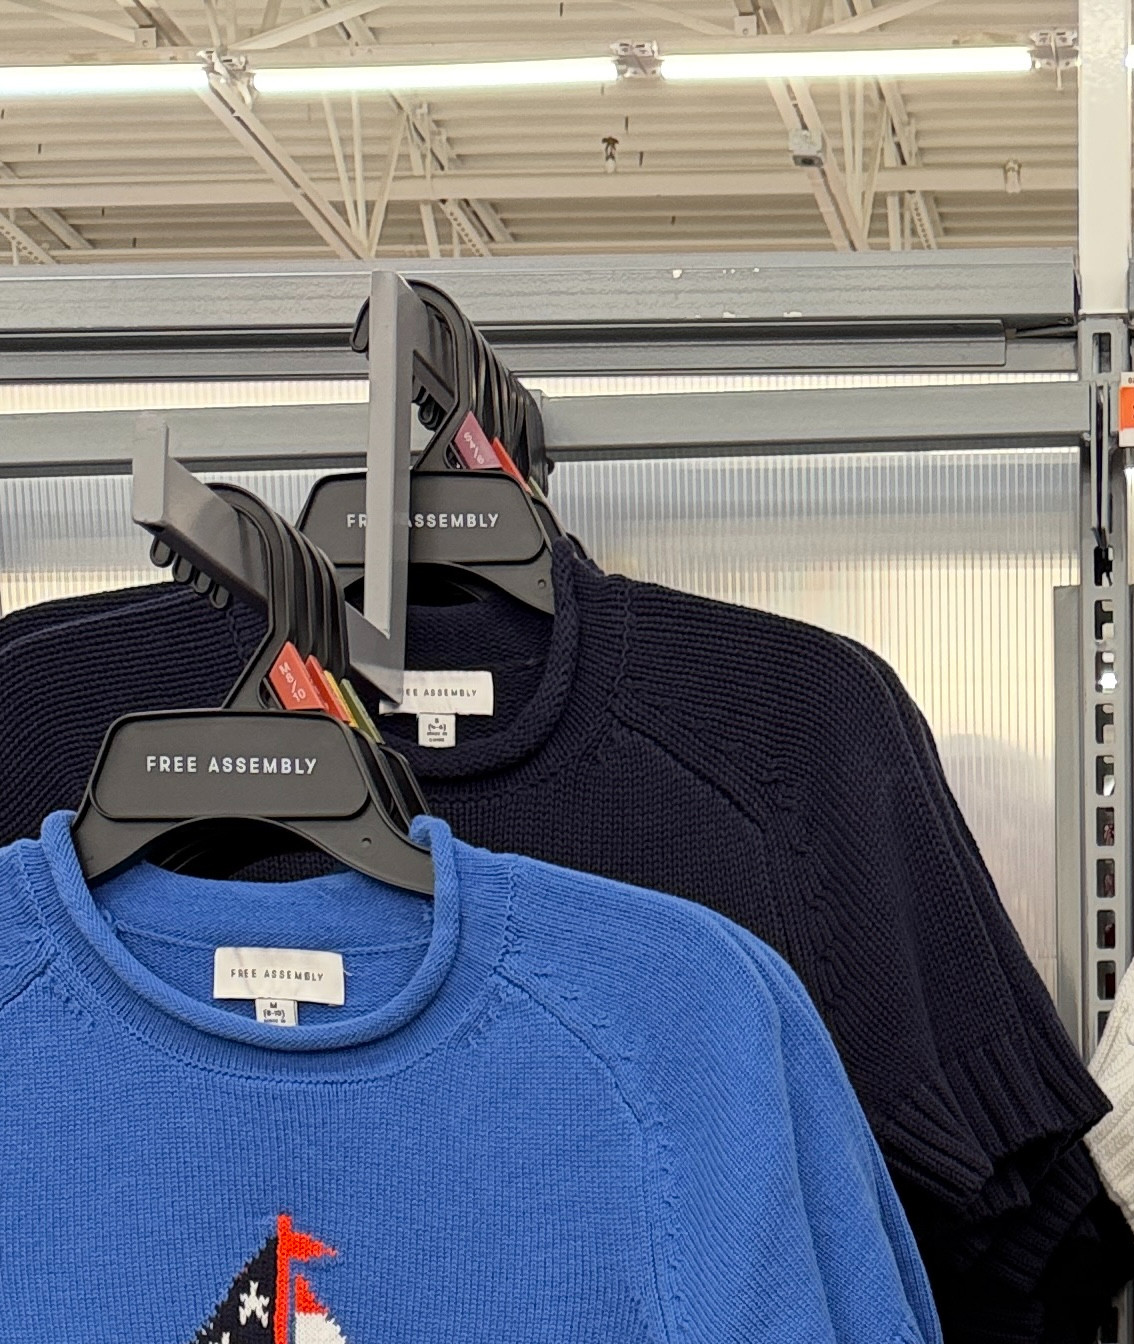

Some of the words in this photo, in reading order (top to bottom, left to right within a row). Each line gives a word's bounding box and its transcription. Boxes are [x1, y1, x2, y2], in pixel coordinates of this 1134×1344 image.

[347, 513, 367, 528] FR
[279, 661, 290, 675] M
[423, 688, 477, 697] ASSEMBLY
[146, 755, 198, 773] FREE
[208, 756, 318, 775] ASSEMBLY
[230, 968, 257, 978] FREE
[264, 969, 324, 982] ASSEMBLY
